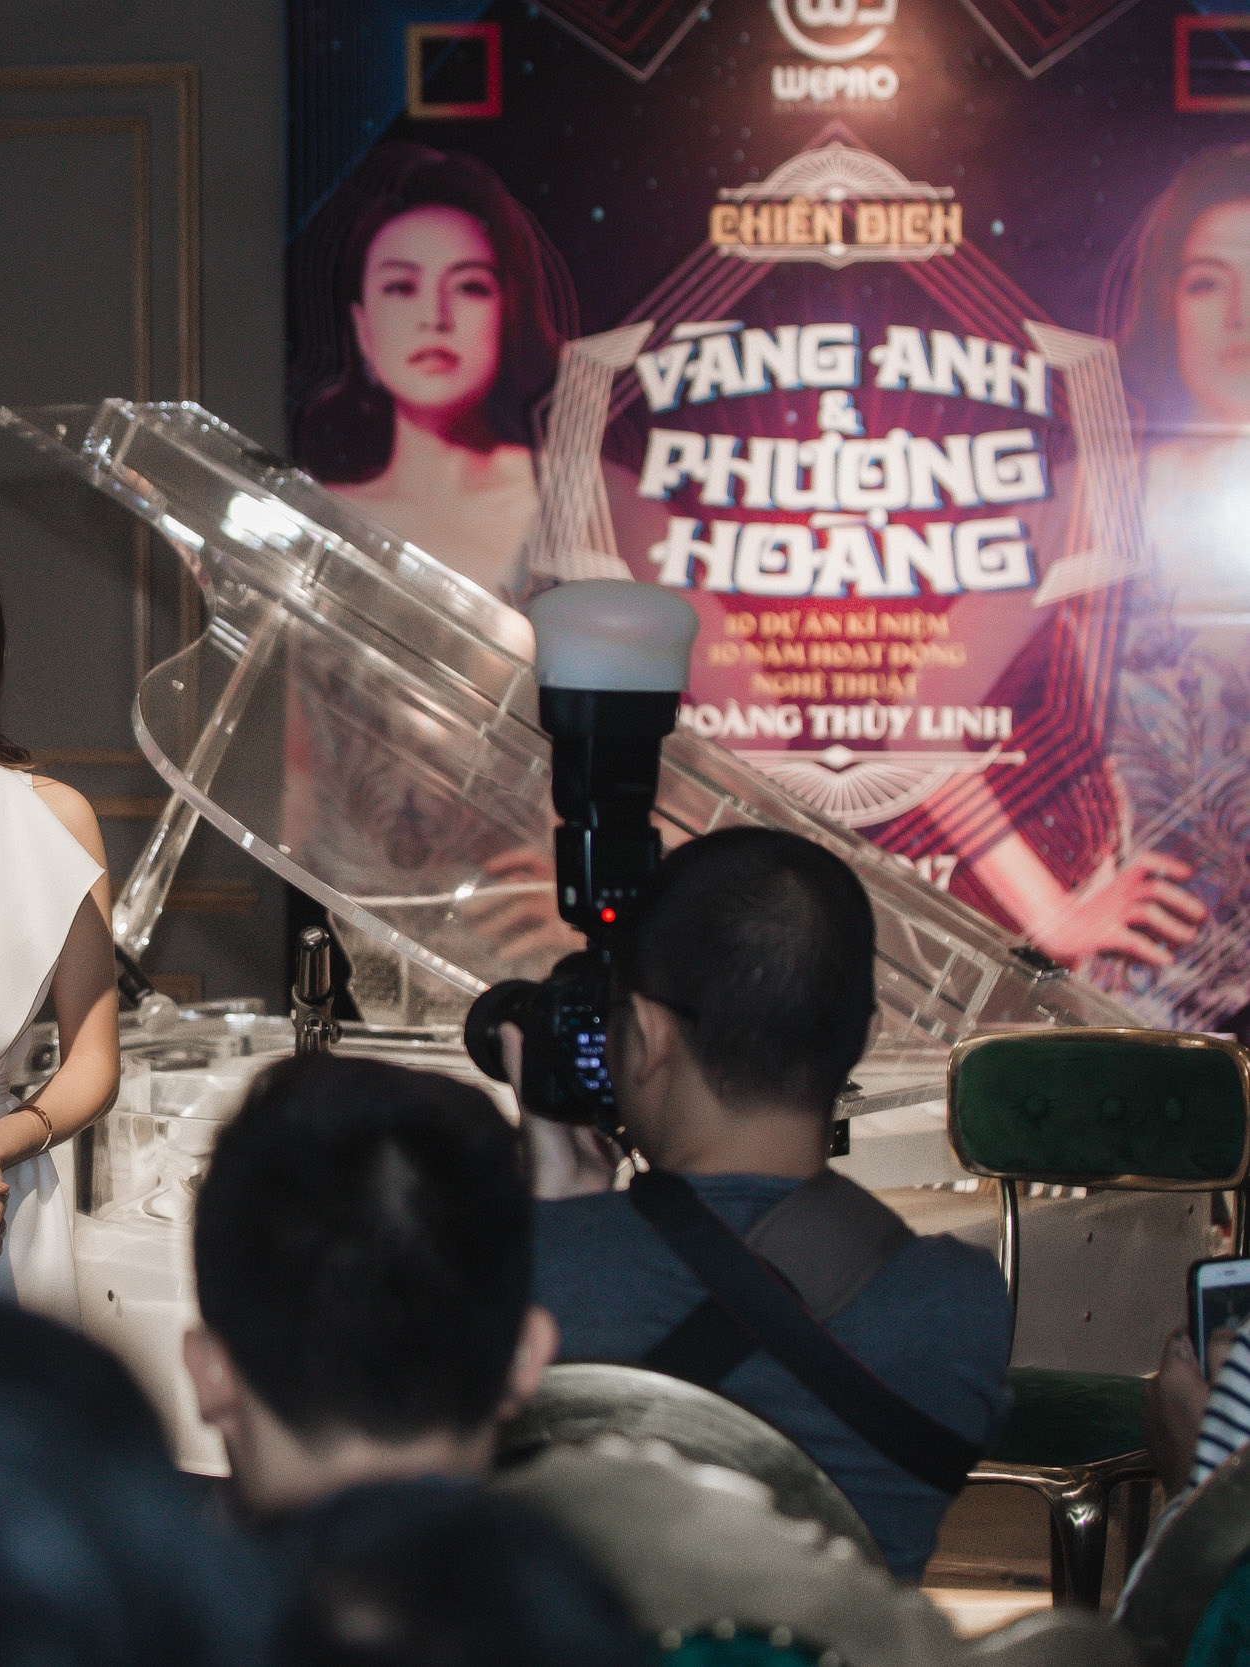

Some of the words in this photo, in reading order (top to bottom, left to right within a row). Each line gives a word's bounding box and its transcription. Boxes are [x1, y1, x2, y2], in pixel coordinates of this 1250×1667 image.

[770, 64, 899, 101] WEPRO
[855, 202, 963, 251] DỊCH
[634, 320, 860, 412] VÀNG
[868, 324, 1050, 417] ANH
[818, 389, 865, 434] &
[636, 427, 1048, 527] PHƯỢNG
[648, 512, 1036, 597] HOÀNG
[917, 704, 1014, 742] LINH
